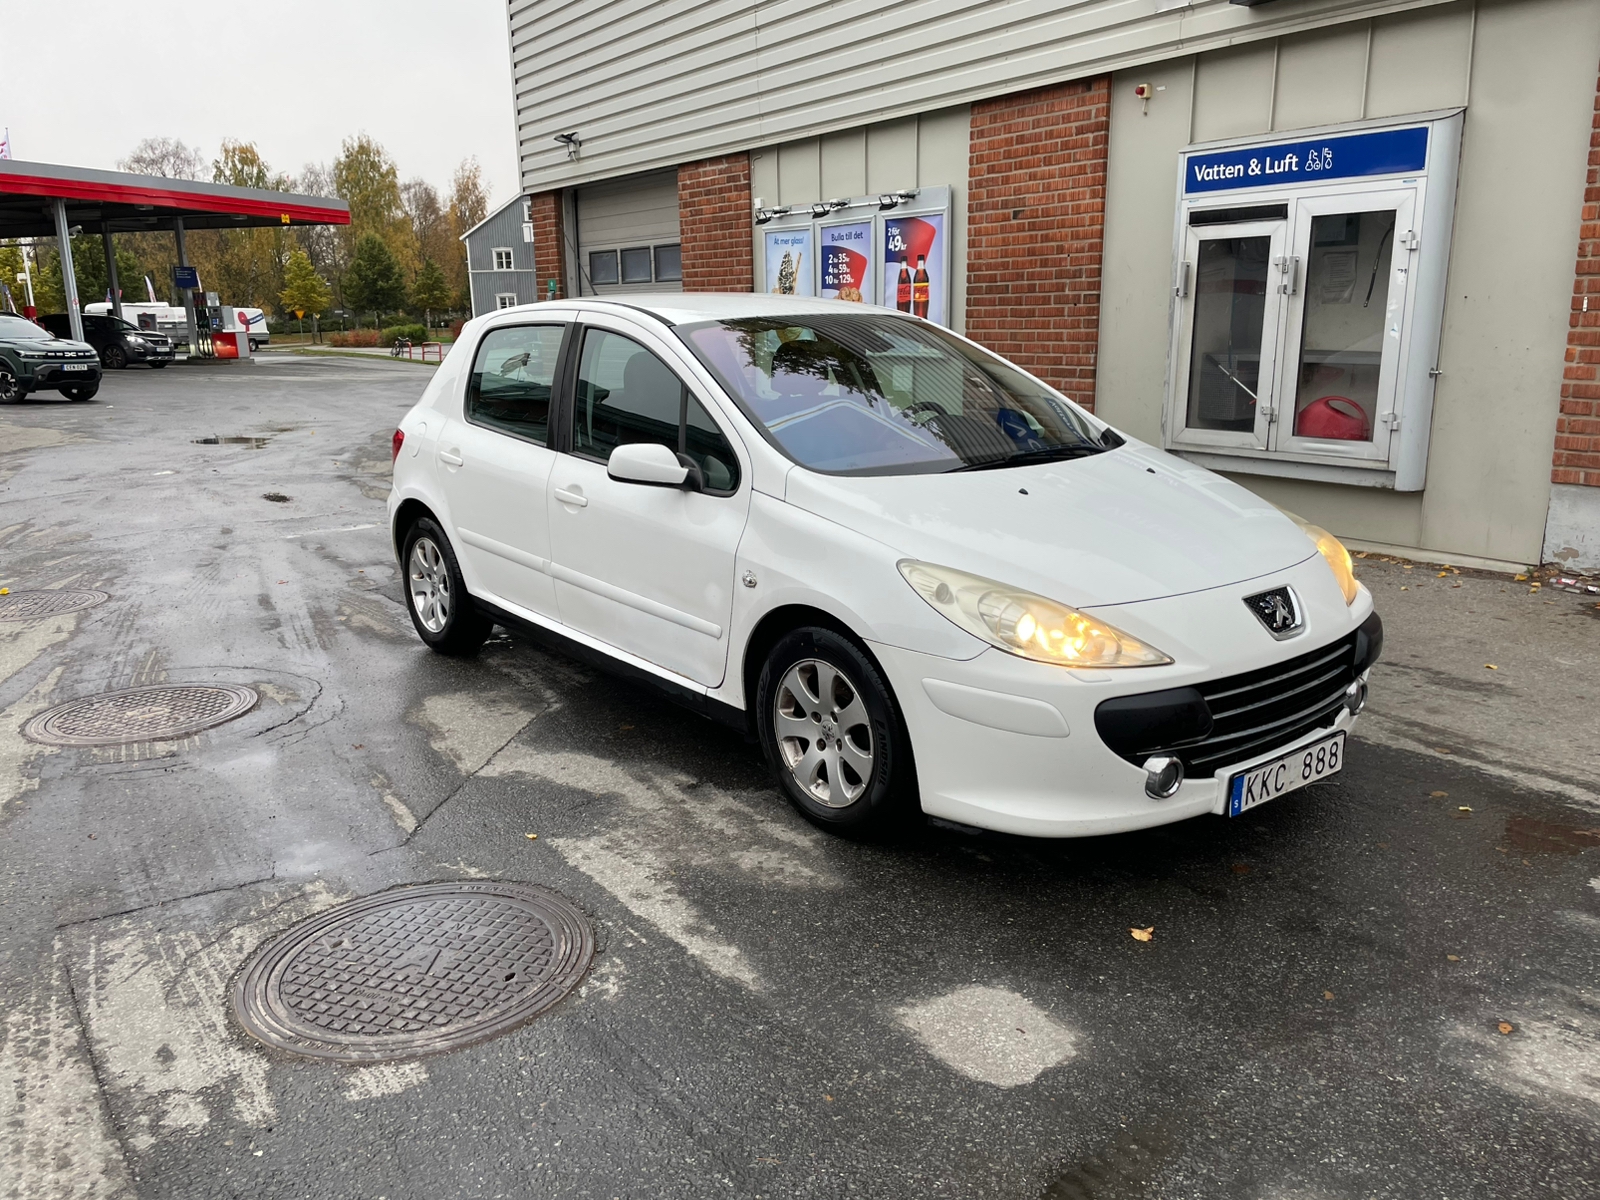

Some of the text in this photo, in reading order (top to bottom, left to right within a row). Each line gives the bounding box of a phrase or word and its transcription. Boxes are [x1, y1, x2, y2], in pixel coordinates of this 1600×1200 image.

[1194, 153, 1299, 182] Vatten & Luft
[831, 232, 844, 242] Bulla
[854, 231, 863, 240] det
[888, 228, 892, 236] 2
[828, 254, 834, 263] 2
[828, 265, 833, 273] 4
[825, 275, 833, 284] 10
[874, 718, 889, 787] LANDSAIL
[1245, 741, 1339, 806] KKC 888
[1234, 799, 1239, 808] S
